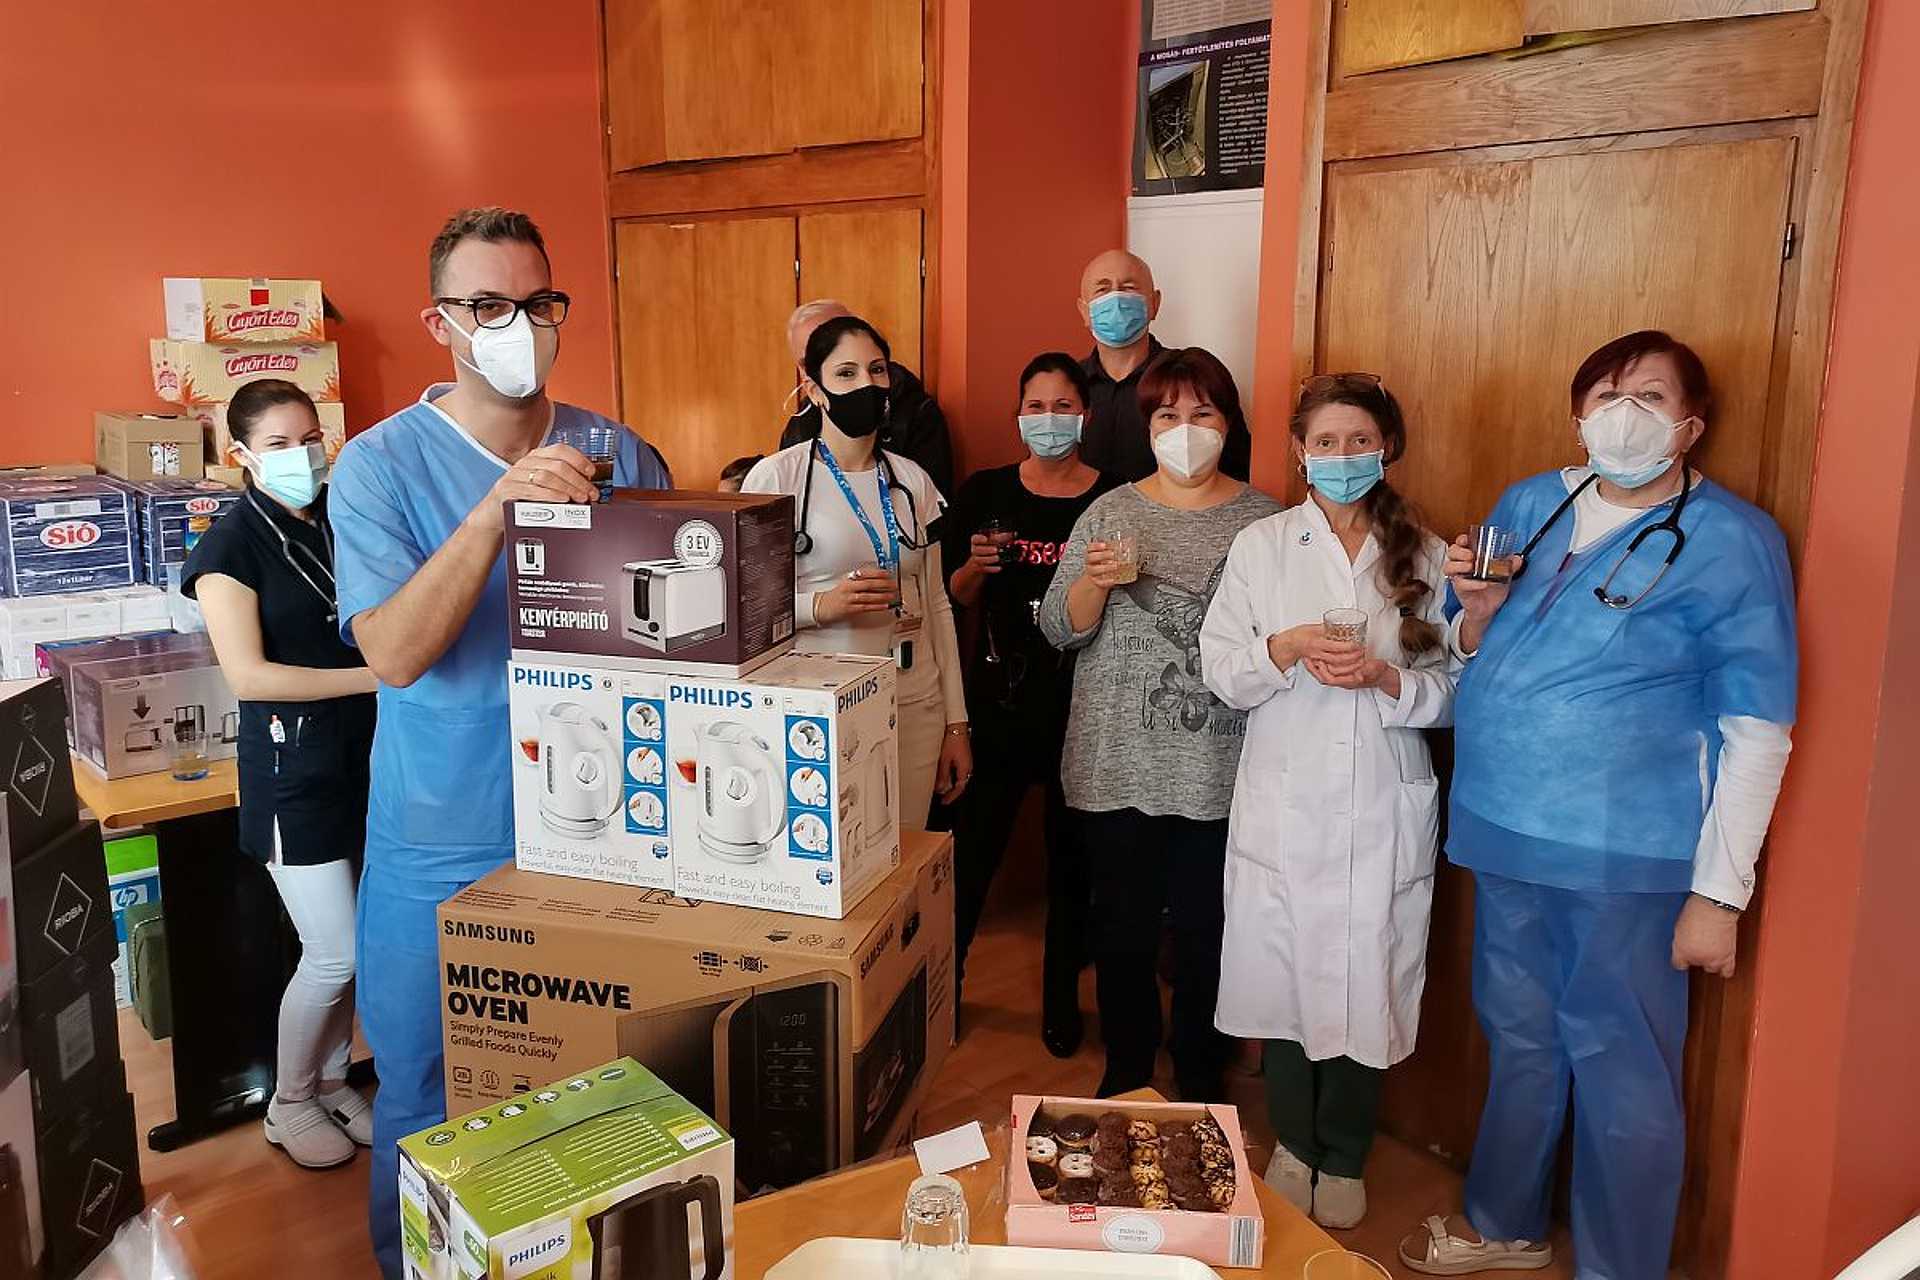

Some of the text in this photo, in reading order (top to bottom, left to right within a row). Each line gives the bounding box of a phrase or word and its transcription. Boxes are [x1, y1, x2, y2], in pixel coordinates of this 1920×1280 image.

[687, 532, 710, 549] 3 ÉV
[519, 606, 609, 631] KENYÉRPIRÍTÓ
[514, 667, 593, 690] PHILIPS
[669, 685, 753, 709] PHILIPS
[837, 676, 878, 713] PHILIPS
[520, 841, 639, 873] Fast and easy boiling
[677, 866, 801, 899] Fast and easy boiling
[444, 920, 536, 945] SAMSUNG
[447, 962, 632, 1010] MICROWAVE
[448, 991, 529, 1024] OVEN
[450, 1020, 564, 1049] Simply Prepare Evenly
[450, 1035, 558, 1062] Grilled Foods Quickly
[509, 1234, 566, 1267] PHILIPS
